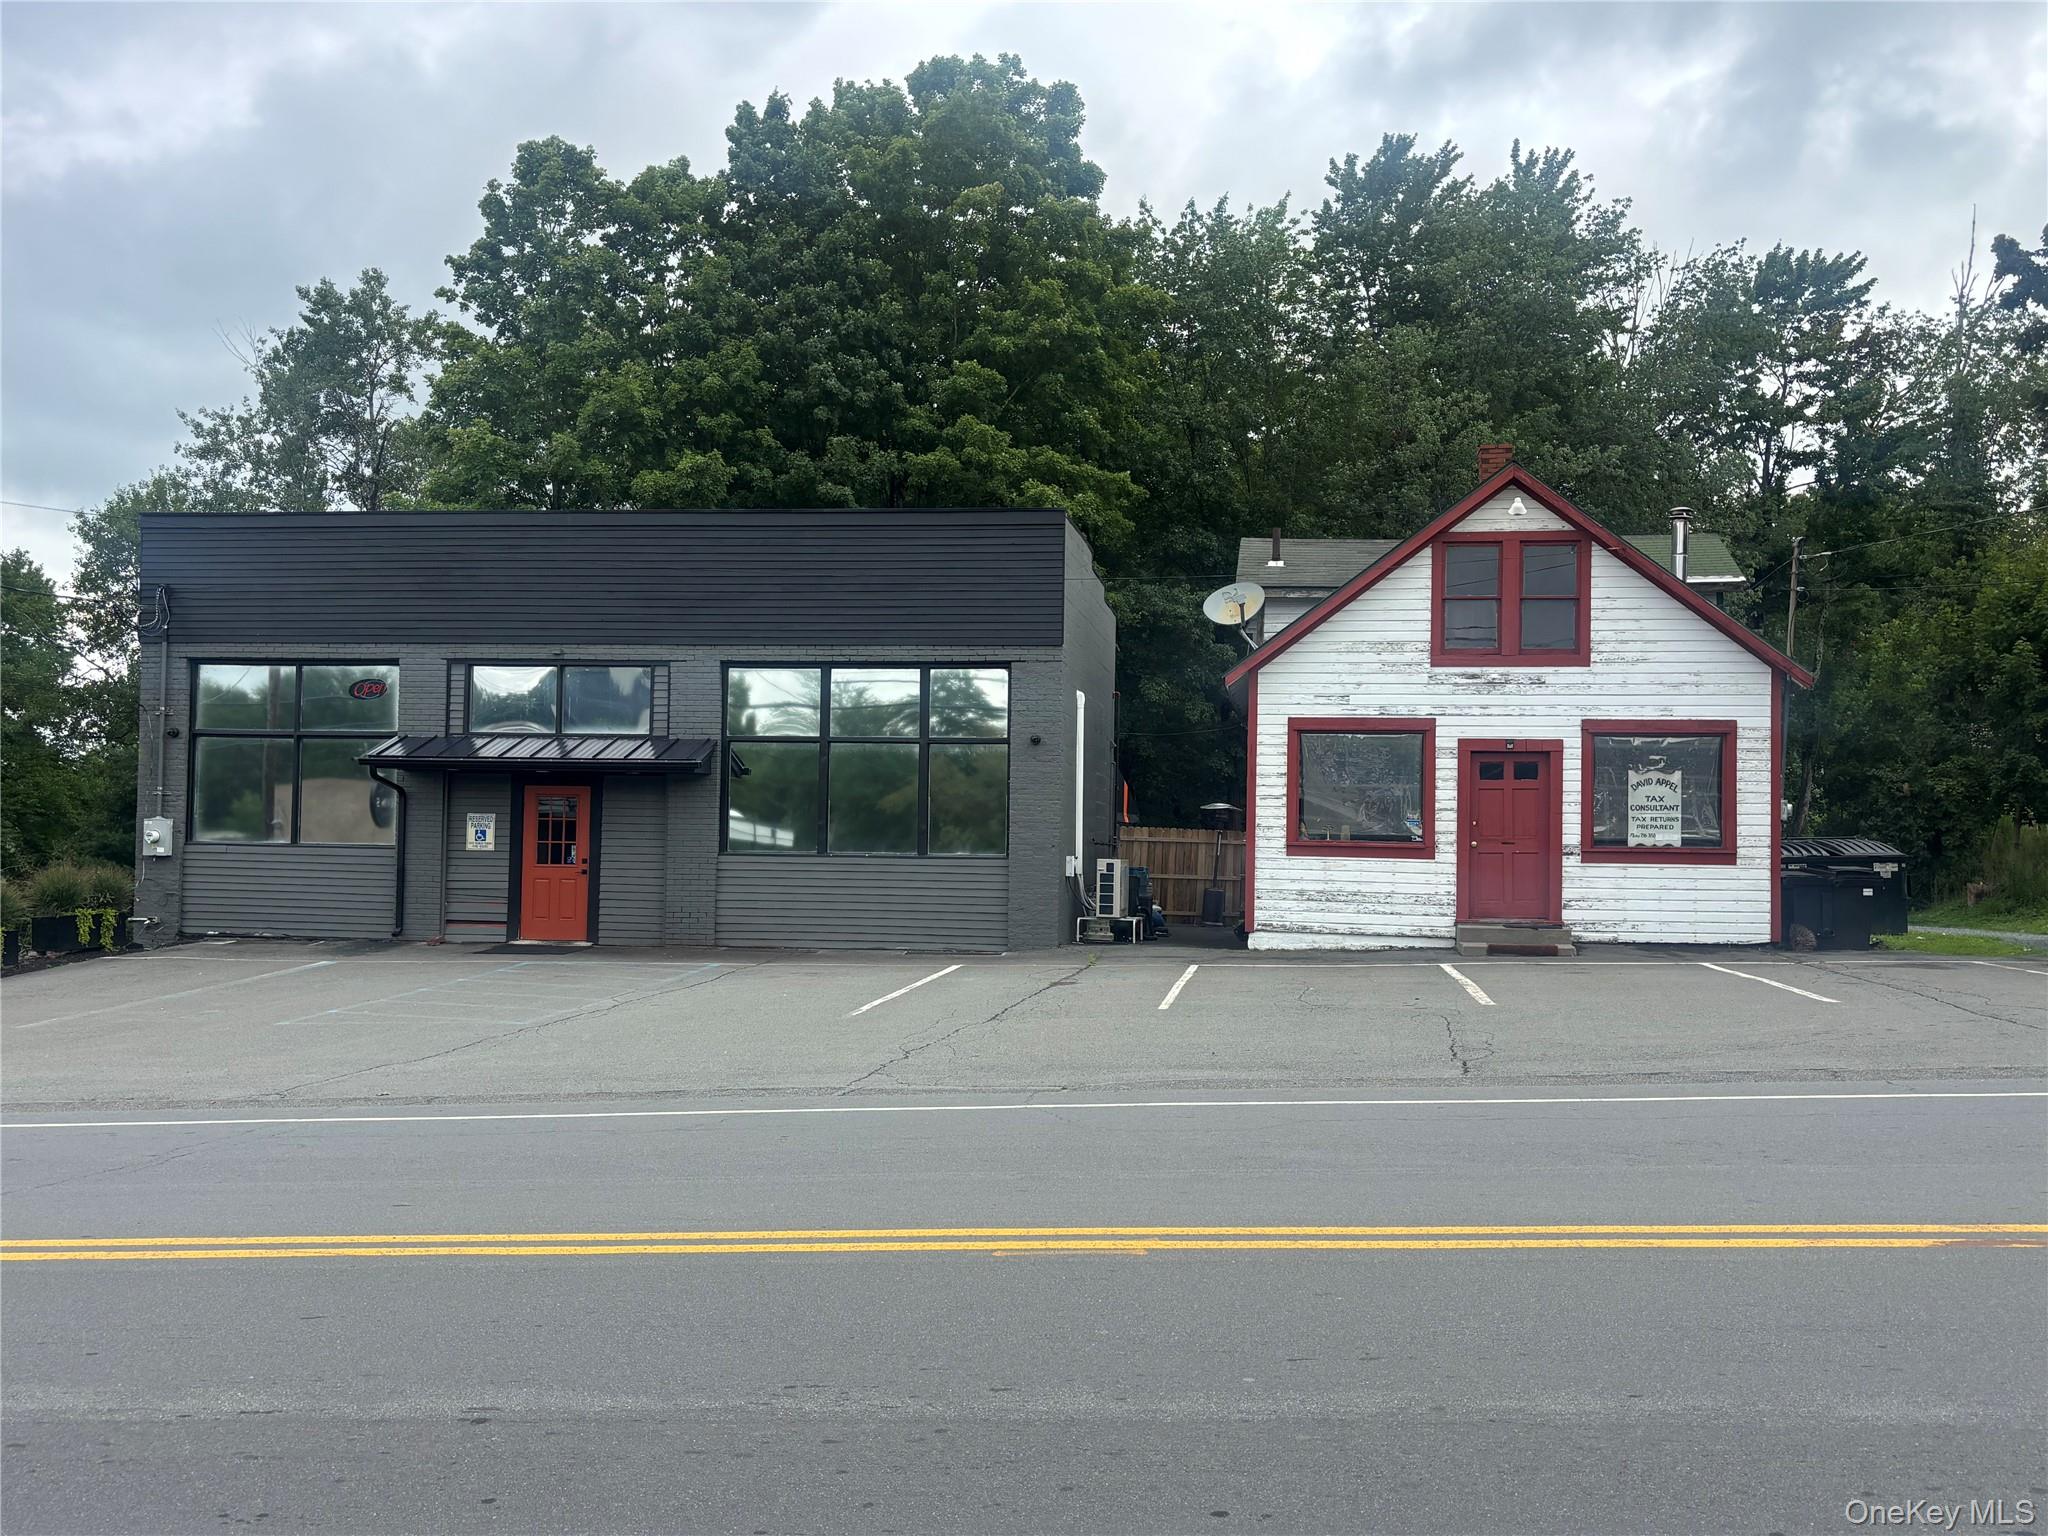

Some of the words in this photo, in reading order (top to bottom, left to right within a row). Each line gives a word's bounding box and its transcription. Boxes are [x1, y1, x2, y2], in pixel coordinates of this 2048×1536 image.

[354, 682, 387, 698] Open
[1630, 777, 1654, 792] DAVID
[1654, 777, 1679, 794] APPEL
[1645, 795, 1665, 803] TAX
[1630, 804, 1680, 812] CONSULTANT
[469, 815, 494, 823] RESERVED
[470, 822, 492, 830] PARKING
